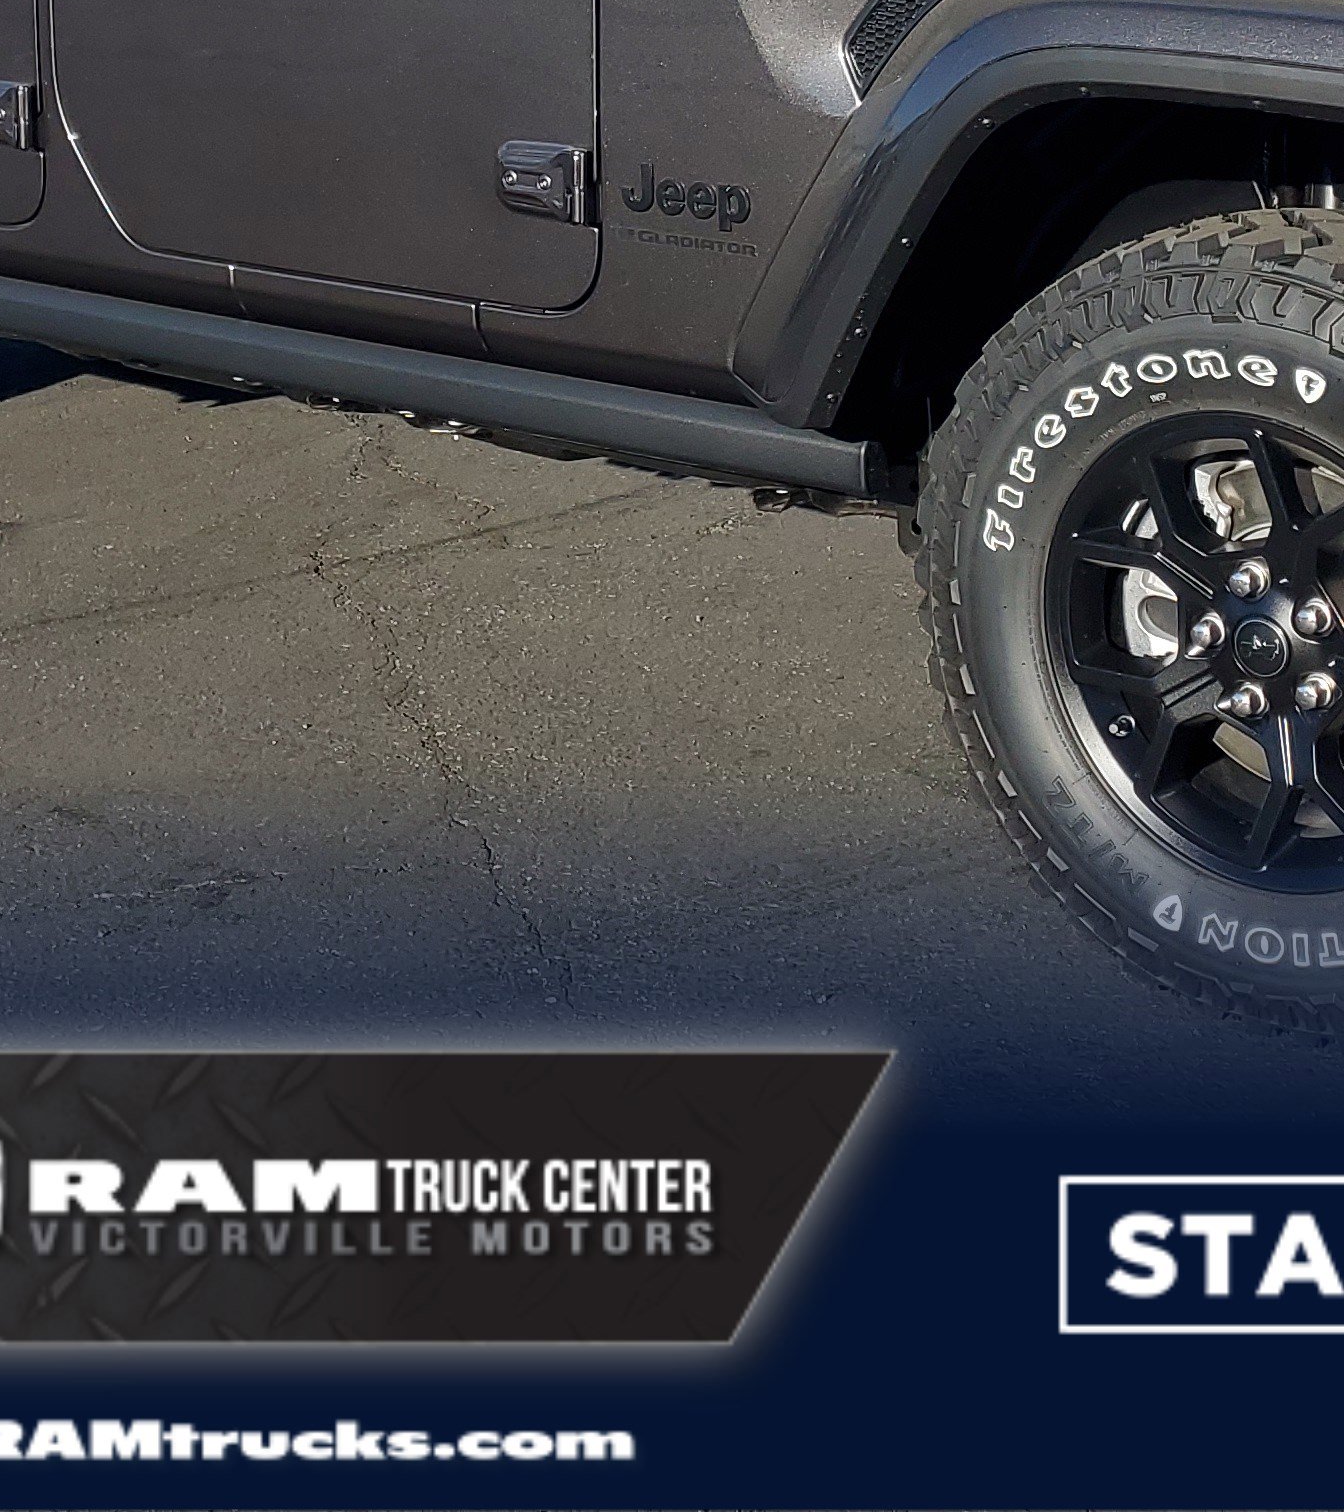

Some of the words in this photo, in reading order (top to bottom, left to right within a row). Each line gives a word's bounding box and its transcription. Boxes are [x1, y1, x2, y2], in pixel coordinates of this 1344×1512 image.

[621, 163, 751, 232] Jeep
[637, 229, 759, 257] GLADIATOR
[984, 349, 1278, 552] Firestone
